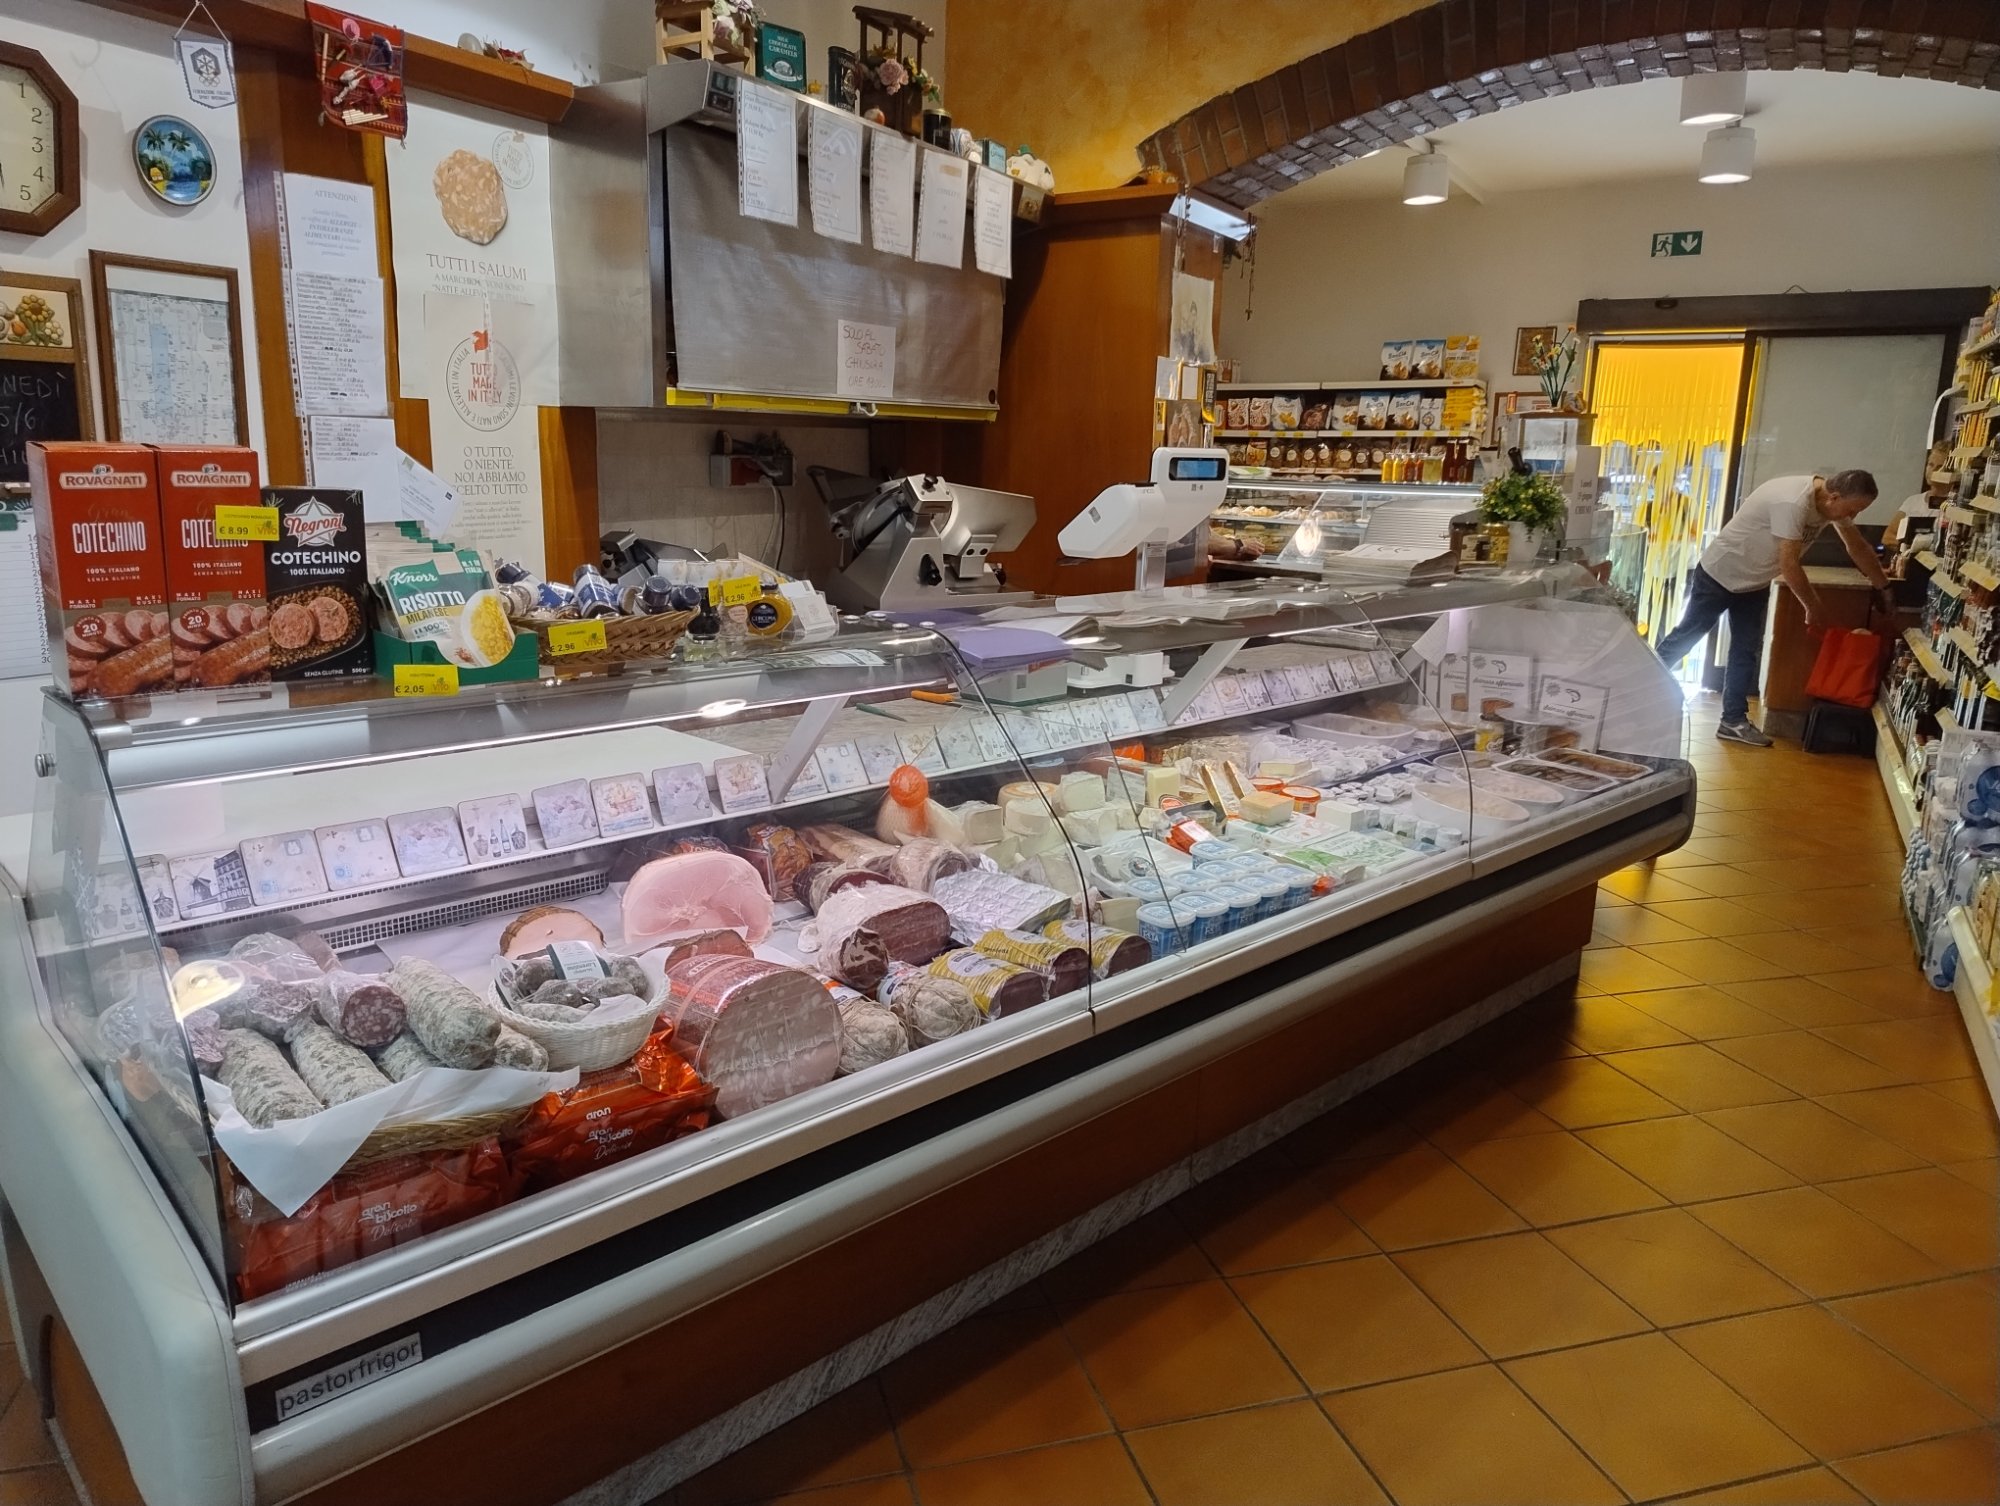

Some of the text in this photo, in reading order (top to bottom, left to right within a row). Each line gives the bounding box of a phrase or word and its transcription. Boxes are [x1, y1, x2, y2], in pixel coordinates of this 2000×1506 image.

[18, 82, 26, 99] 1
[31, 107, 43, 124] 2
[31, 136, 43, 153] 3
[32, 166, 44, 182] 4
[20, 185, 31, 201] 5
[426, 253, 527, 281] TUTTI I SALUMI
[463, 446, 473, 458] O
[463, 459, 473, 471] O
[65, 475, 142, 486] ROVAGNATI
[176, 474, 247, 484] ROVAGNATI
[454, 471, 526, 483] NOI ABBIAMO
[492, 483, 529, 495] TUTTO
[219, 527, 226, 535] €
[257, 526, 278, 536] VIVO
[285, 514, 347, 537] Negroni
[72, 521, 147, 554] COTECHINO
[270, 550, 362, 566] COTECHINO
[289, 566, 345, 576] 100% ITALIANO
[389, 571, 438, 586] Knorr
[399, 590, 466, 615] RISOTTO
[188, 615, 202, 625] 20
[405, 607, 449, 625] MILANESE
[82, 623, 98, 633] 20
[584, 638, 603, 647] VIVO
[304, 670, 321, 678] SENZA
[395, 685, 401, 694] €
[432, 682, 449, 692] VIVO
[357, 1201, 391, 1224] gran
[375, 1203, 418, 1224] biscotto
[280, 1340, 419, 1418] pastorfrigor
